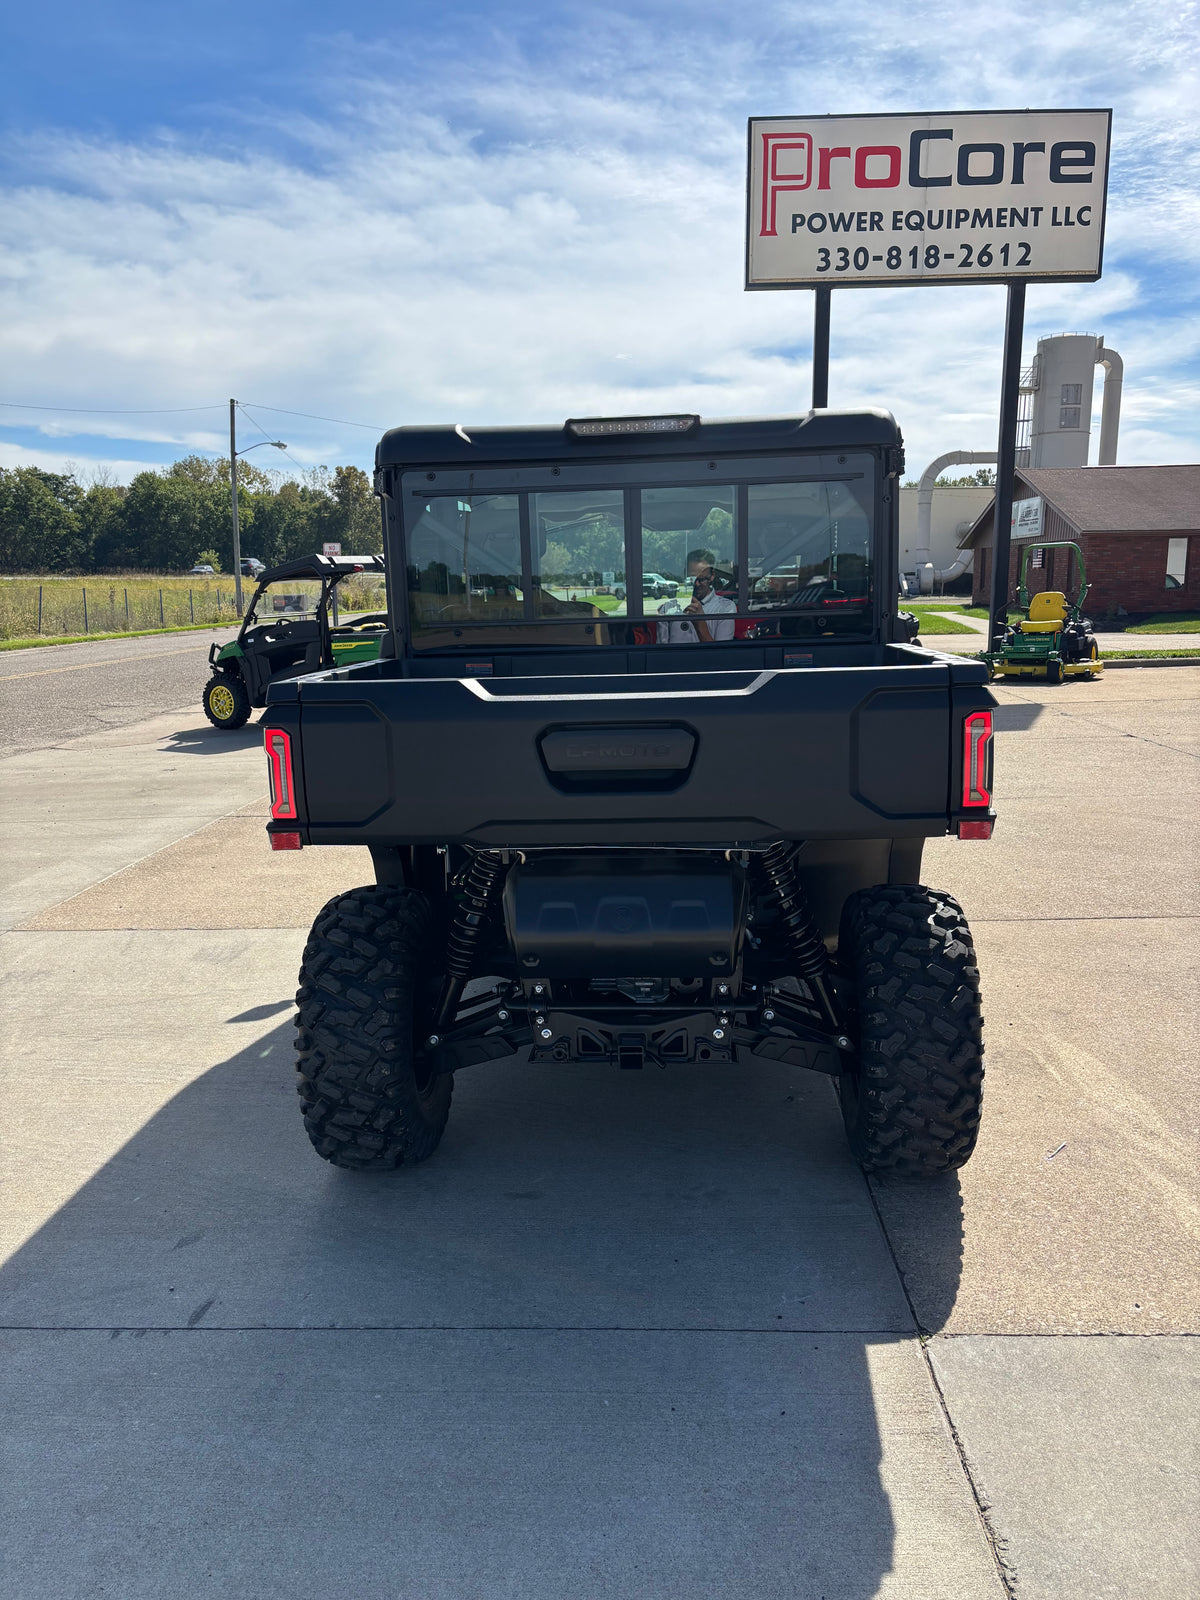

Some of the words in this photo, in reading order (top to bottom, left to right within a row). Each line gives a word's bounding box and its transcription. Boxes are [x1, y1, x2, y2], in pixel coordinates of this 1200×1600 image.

[759, 128, 1096, 236] ProCore
[791, 211, 884, 234] POWER
[892, 206, 1044, 232] EQUIPMENT
[1051, 205, 1092, 227] LLC
[815, 242, 1032, 272] 330-818-2612
